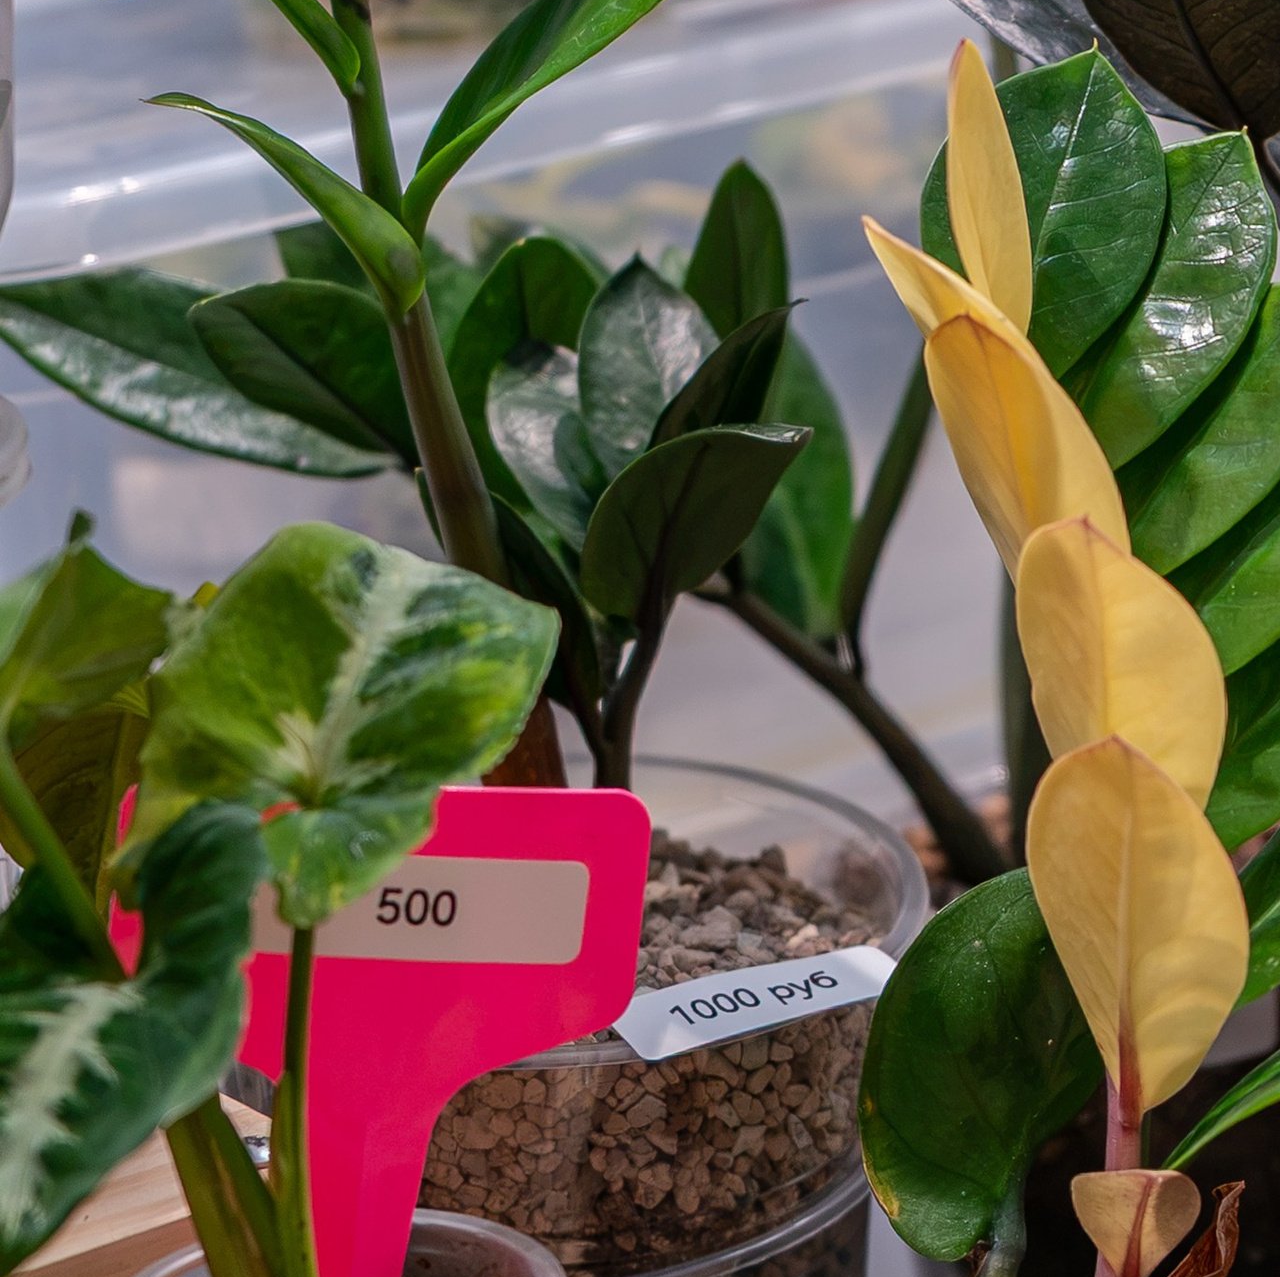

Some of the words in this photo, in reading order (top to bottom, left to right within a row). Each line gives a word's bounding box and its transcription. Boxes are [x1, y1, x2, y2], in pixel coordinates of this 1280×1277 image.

[376, 887, 457, 927] 500
[669, 987, 761, 1025] 1000
[767, 970, 839, 1005] руб
